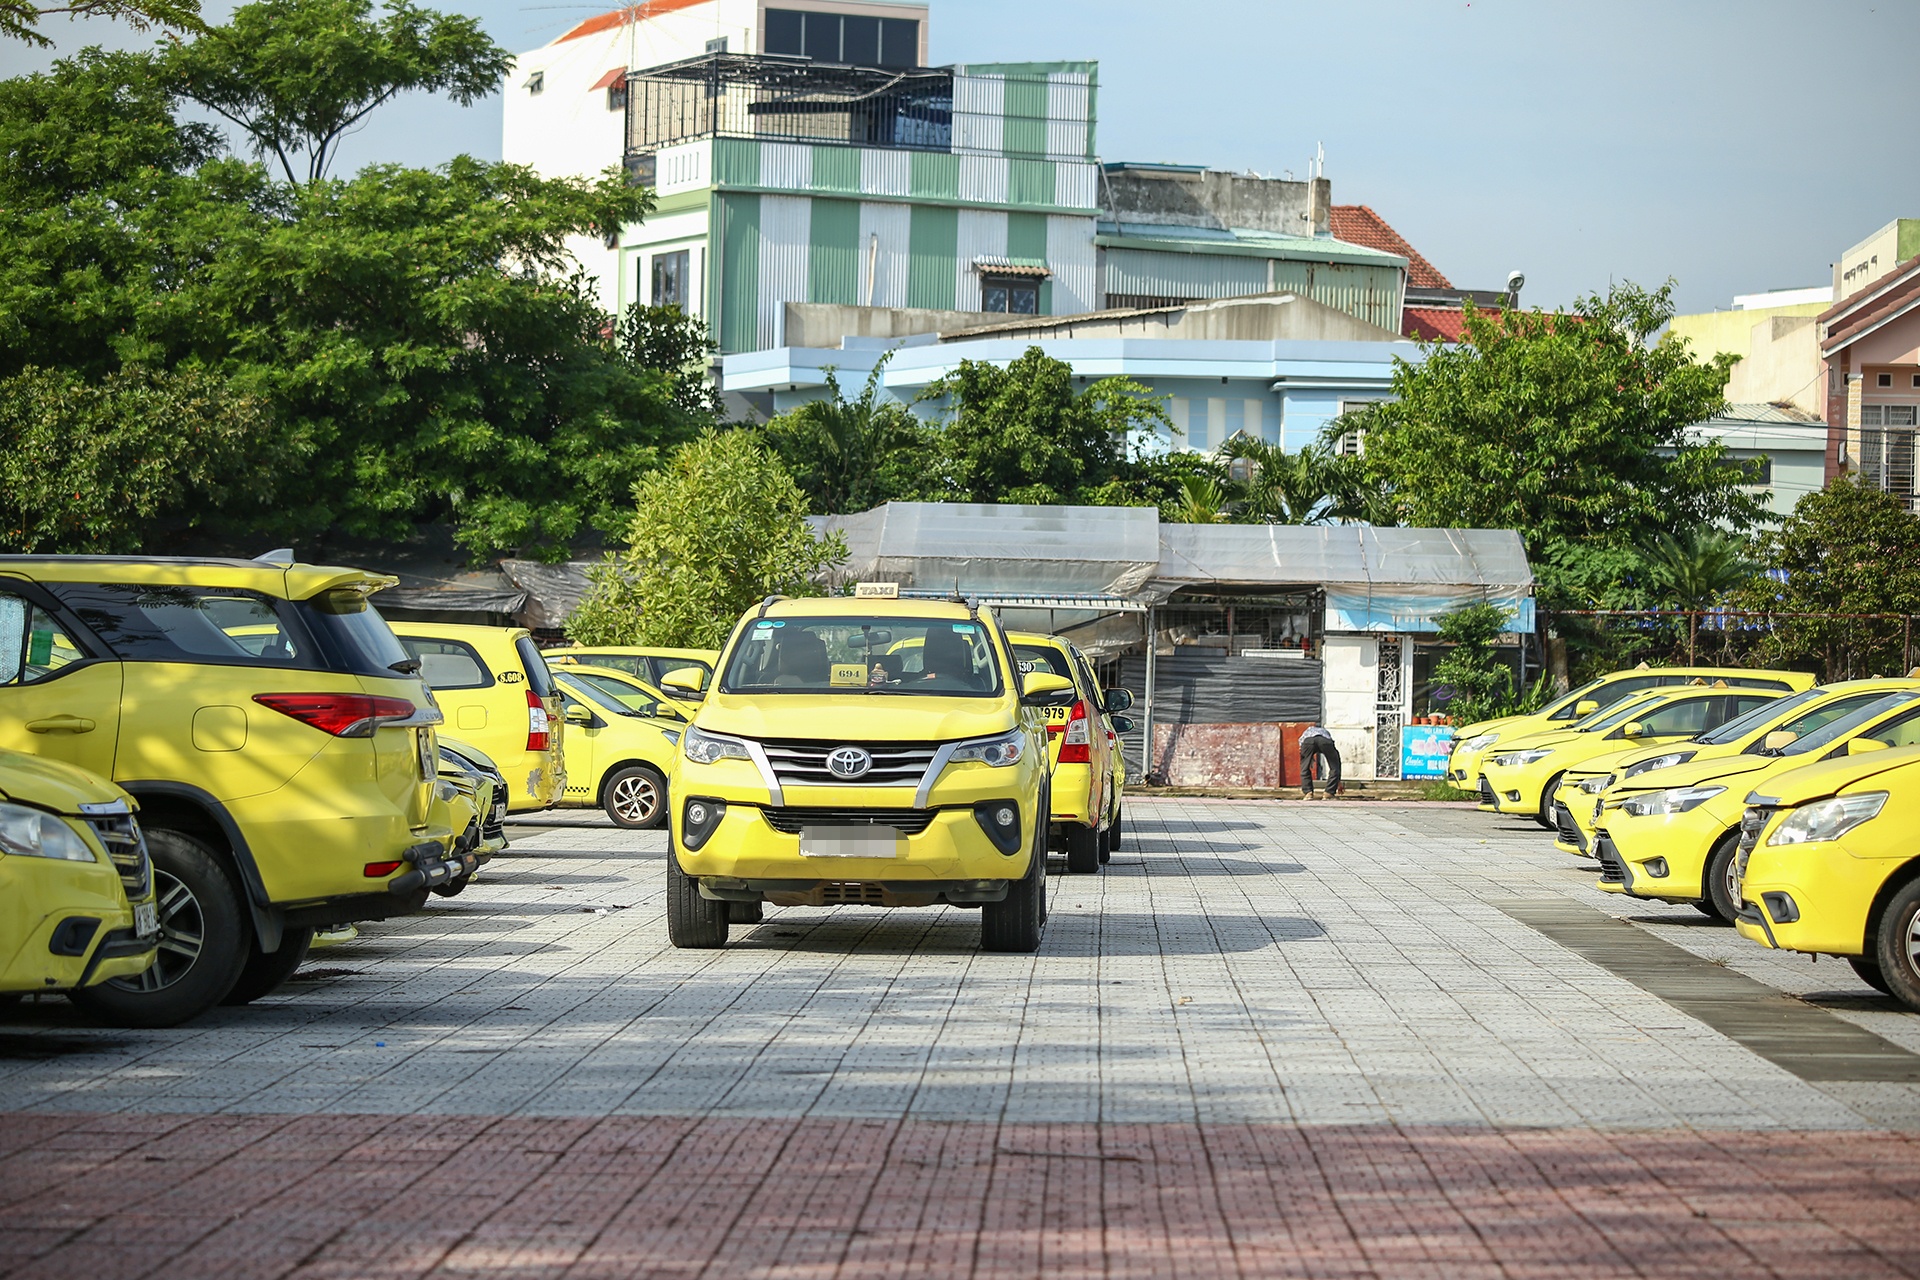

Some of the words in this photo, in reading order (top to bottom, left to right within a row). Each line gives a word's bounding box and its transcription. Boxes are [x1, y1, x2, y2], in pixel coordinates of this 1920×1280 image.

[860, 586, 895, 595] TAXI
[838, 670, 860, 678] 694
[1041, 707, 1064, 719] 979
